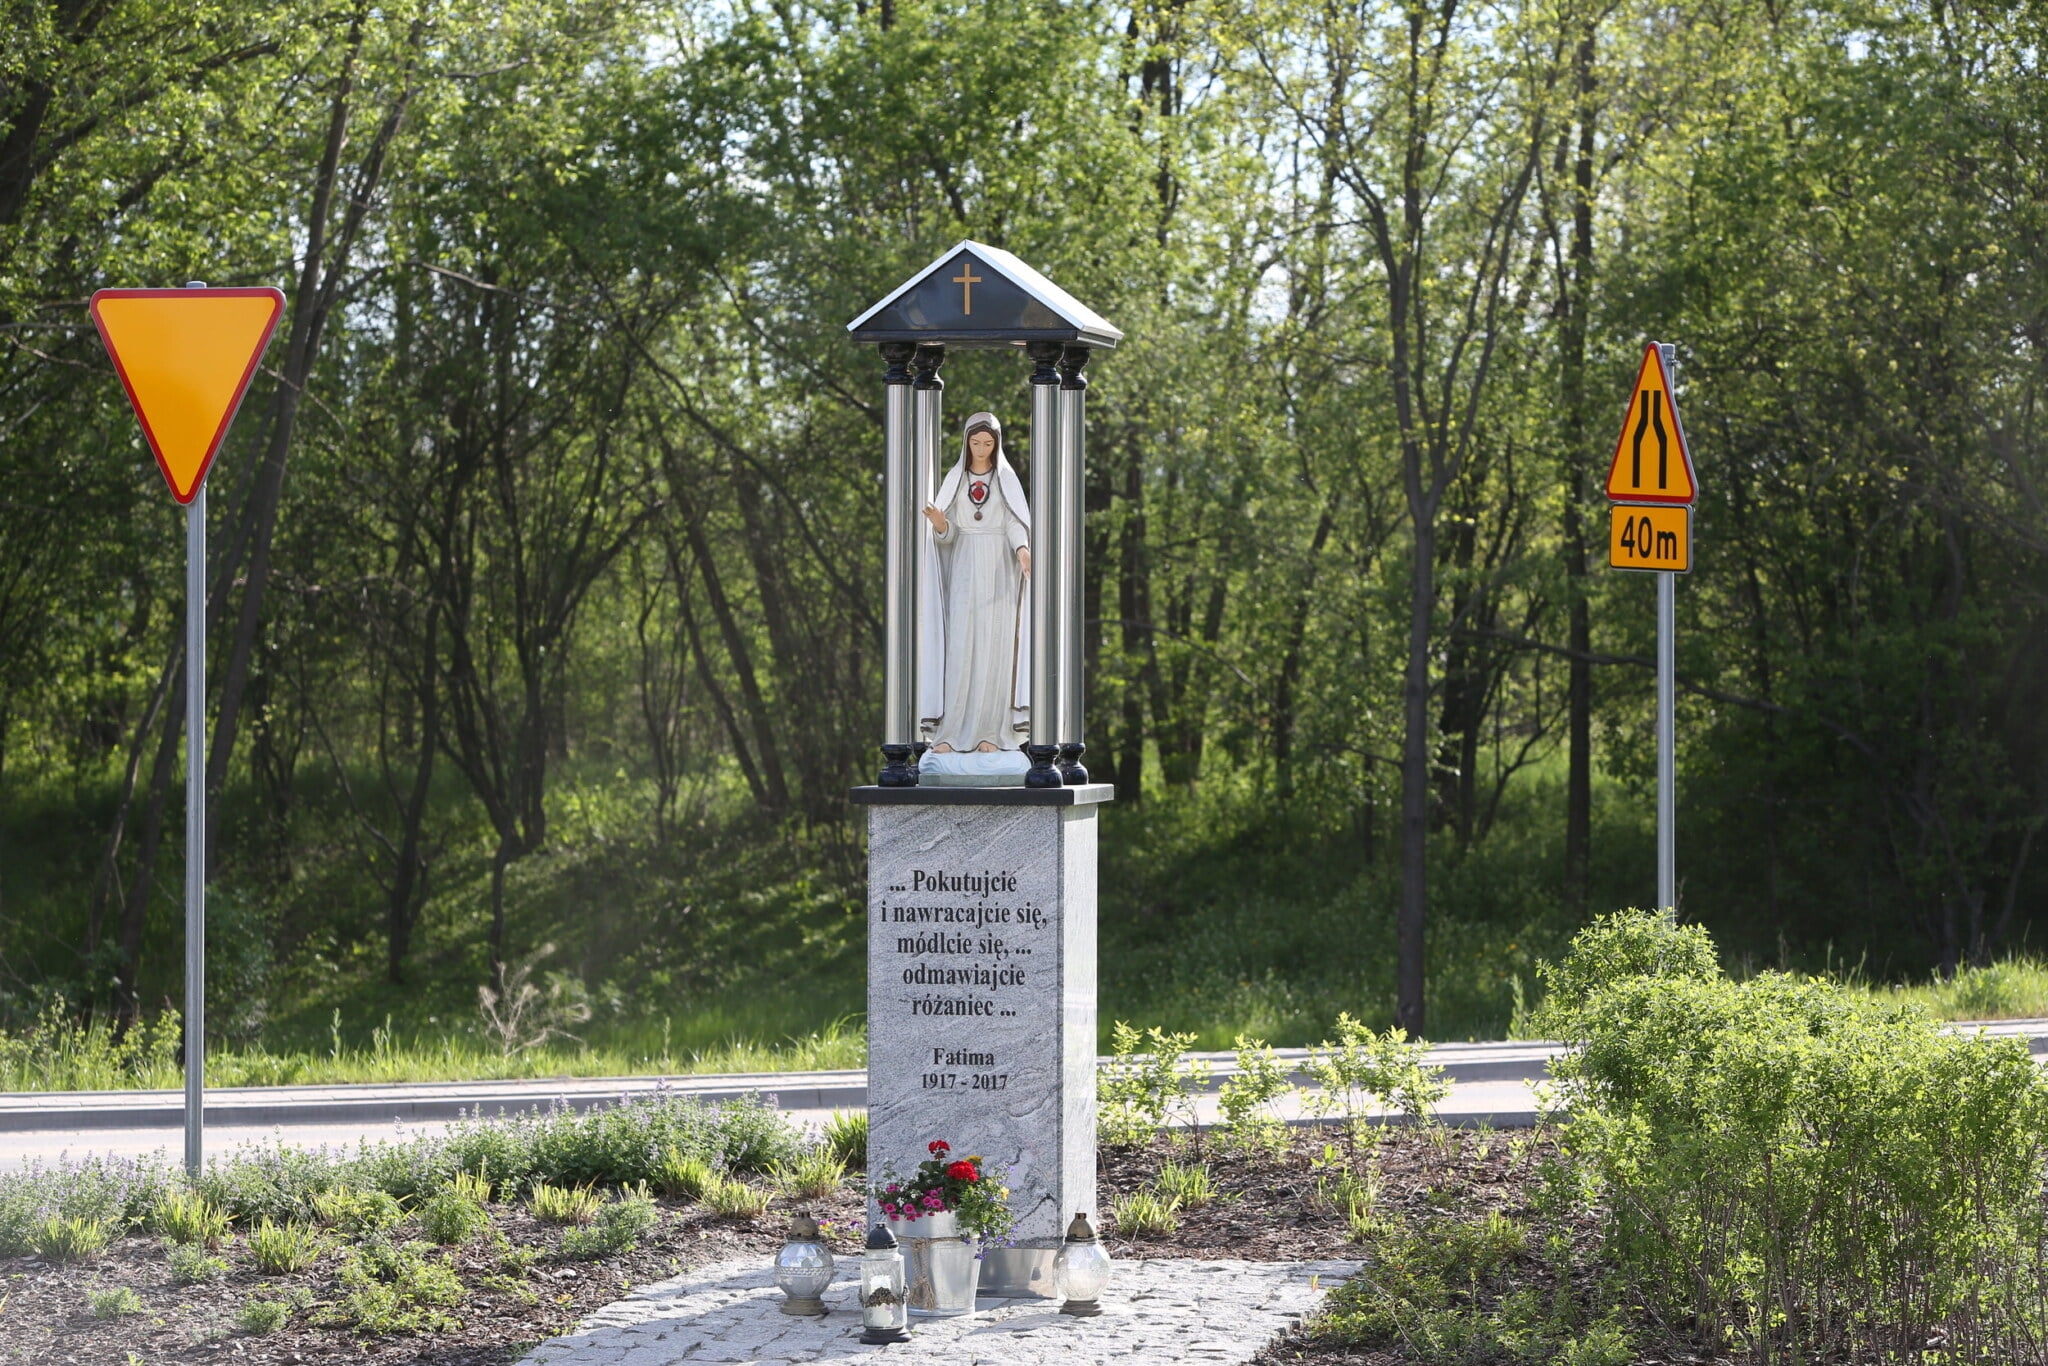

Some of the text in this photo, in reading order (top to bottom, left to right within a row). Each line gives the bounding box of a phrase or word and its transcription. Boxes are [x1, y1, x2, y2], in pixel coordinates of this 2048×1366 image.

[912, 869, 1017, 898] Pokutujcie
[881, 901, 1047, 930] i nawracajcie się,
[897, 931, 972, 954] módlcie
[979, 934, 1009, 961] się,
[903, 963, 1026, 991] odmawiajcie
[912, 993, 994, 1016] różaniec
[933, 1048, 995, 1066] Fatima
